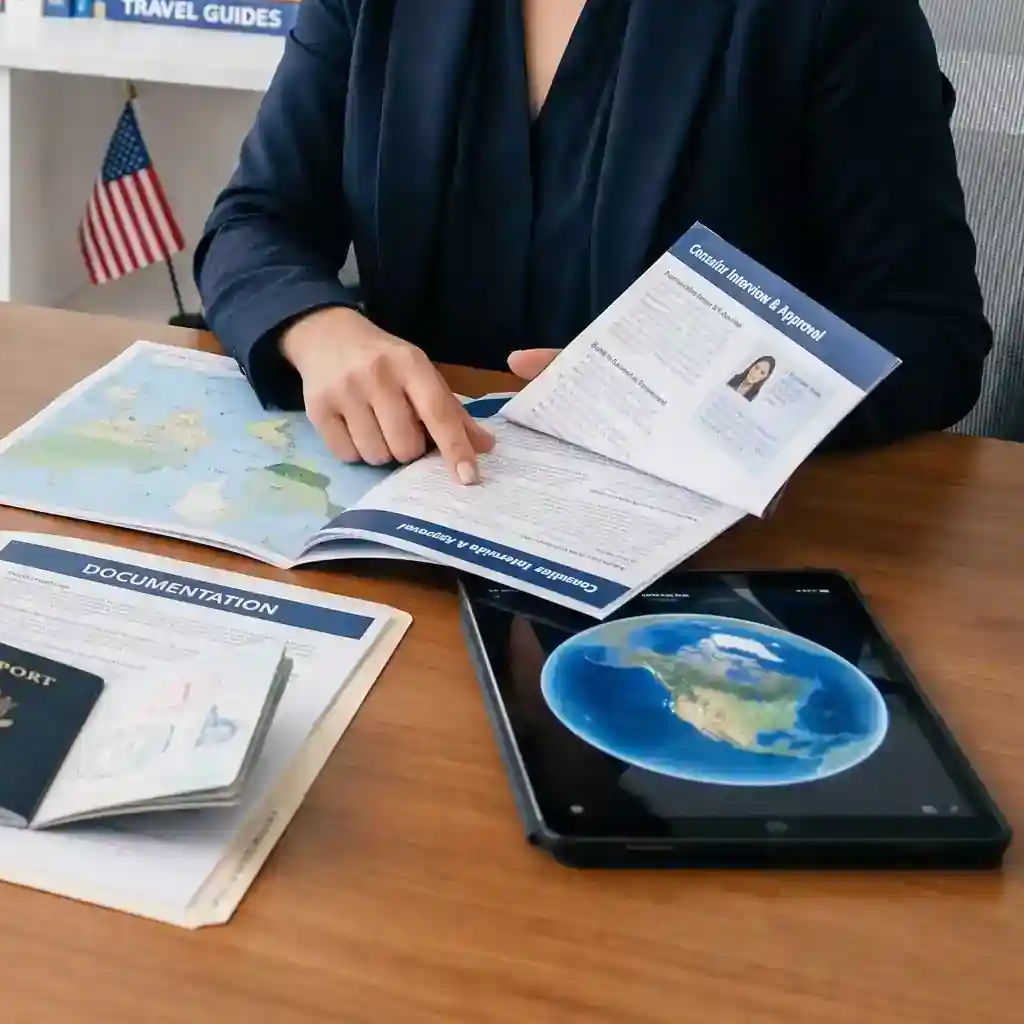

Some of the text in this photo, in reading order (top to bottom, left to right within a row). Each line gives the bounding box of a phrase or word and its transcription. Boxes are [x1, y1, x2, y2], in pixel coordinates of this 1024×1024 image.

[203, 4, 283, 28] GUIDES
[777, 305, 827, 342] Approval
[81, 563, 280, 616] DOCUMENTATION
